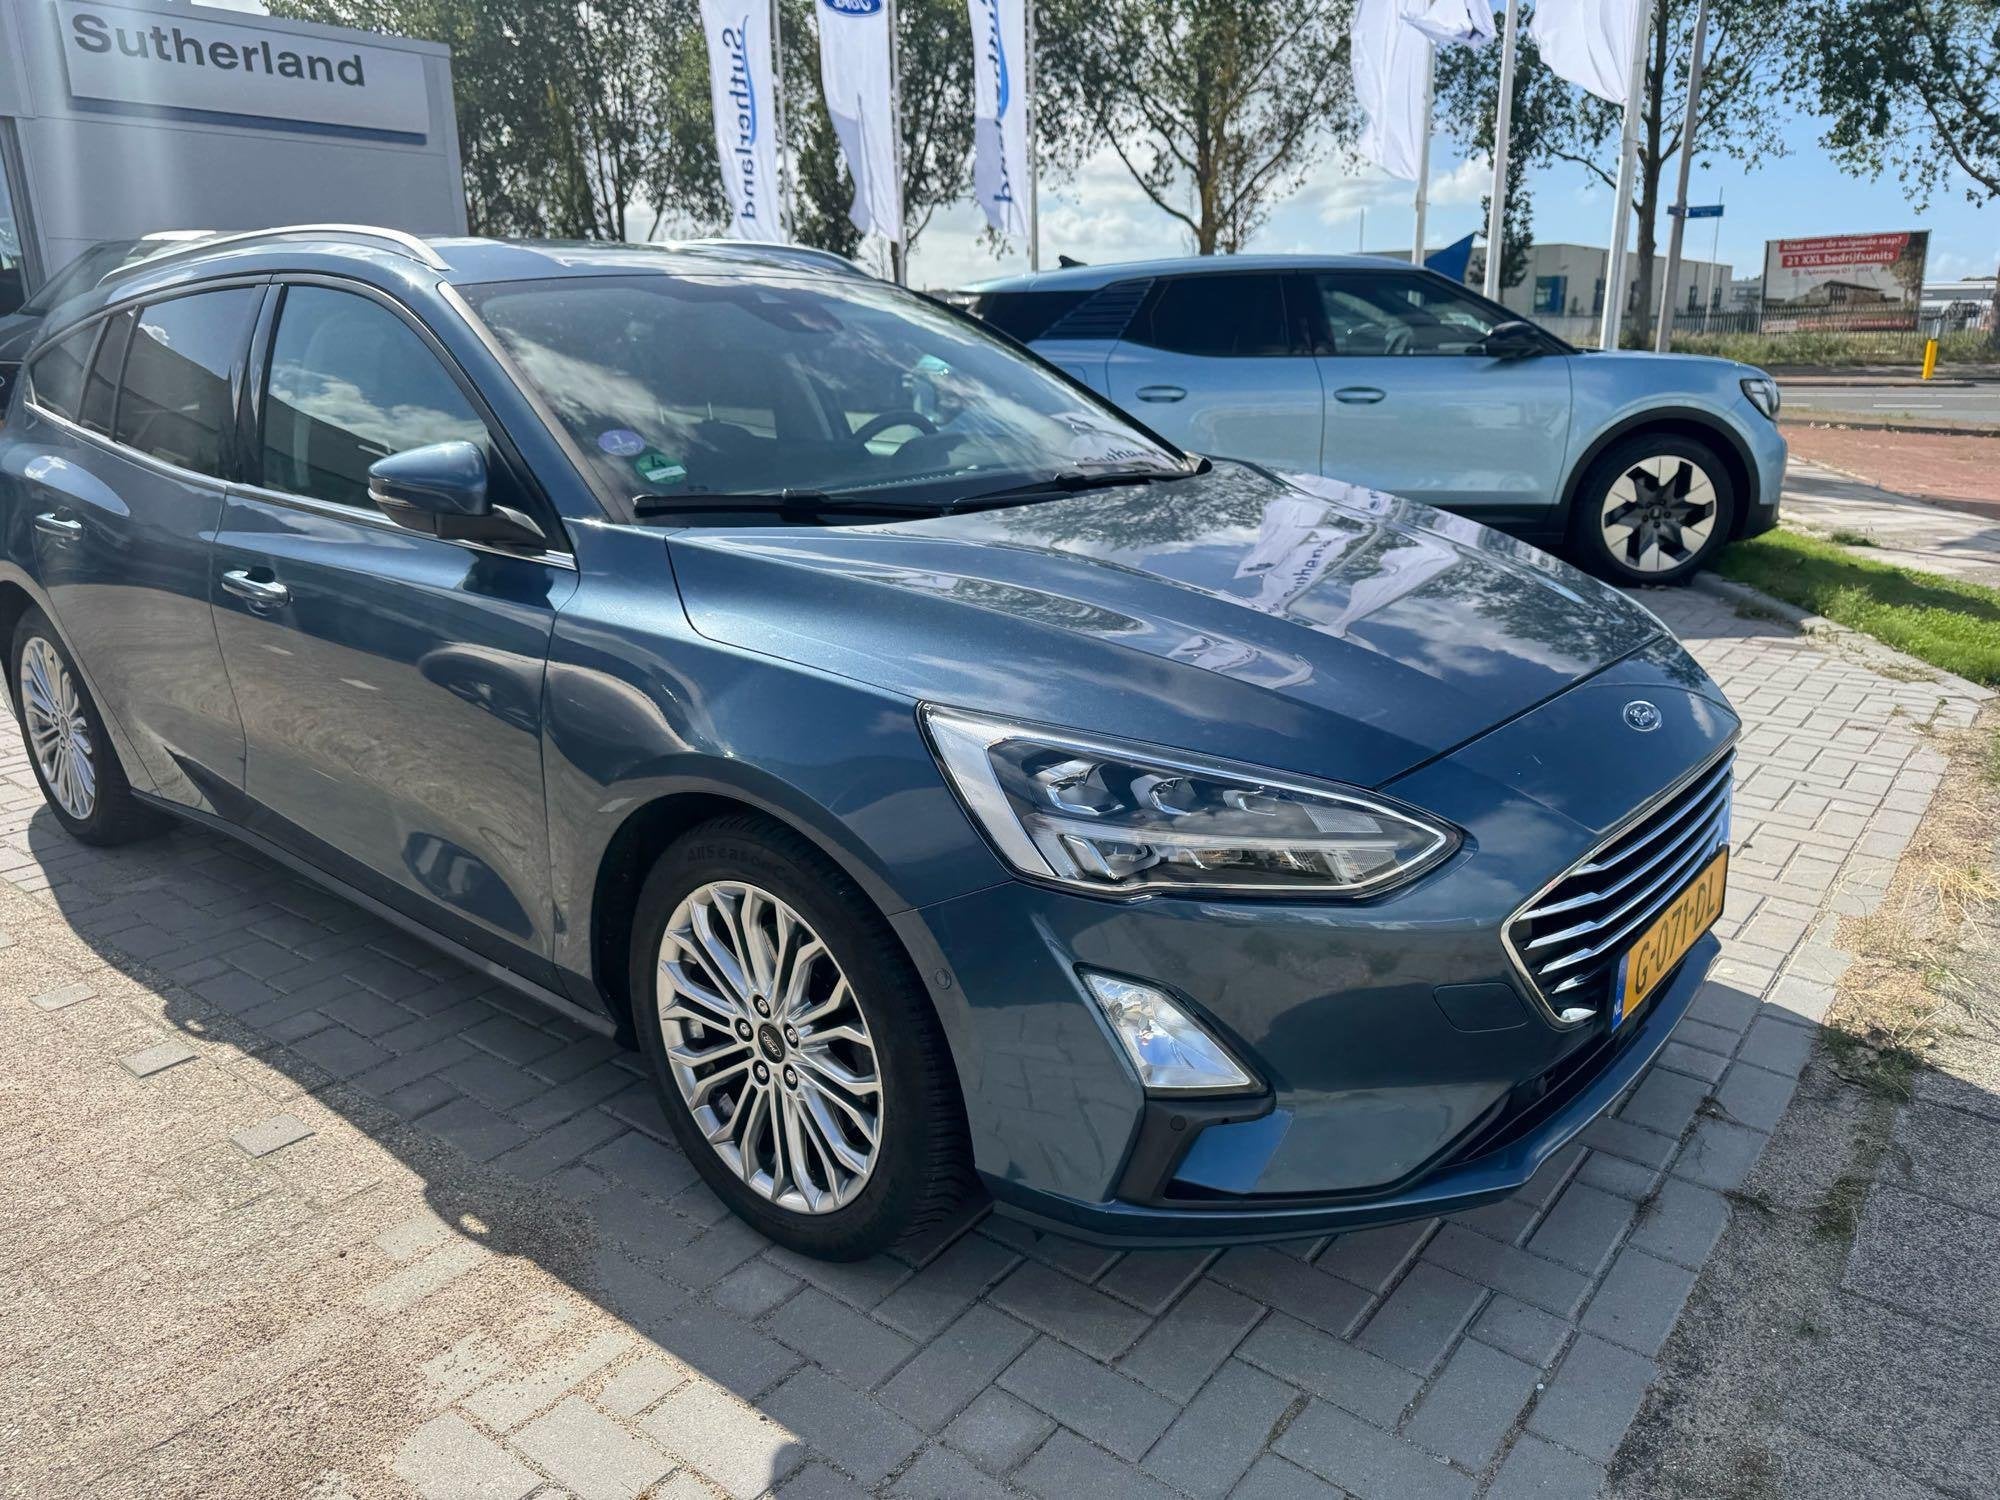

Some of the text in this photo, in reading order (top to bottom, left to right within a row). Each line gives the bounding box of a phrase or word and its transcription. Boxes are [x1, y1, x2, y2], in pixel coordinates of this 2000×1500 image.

[72, 13, 366, 88] Sutherland
[1783, 235, 1902, 251] Klaar voor de volgende stap?
[1786, 251, 1895, 267] 21 XXL bedrijfsunits
[1634, 871, 1716, 995] G-071-DL
